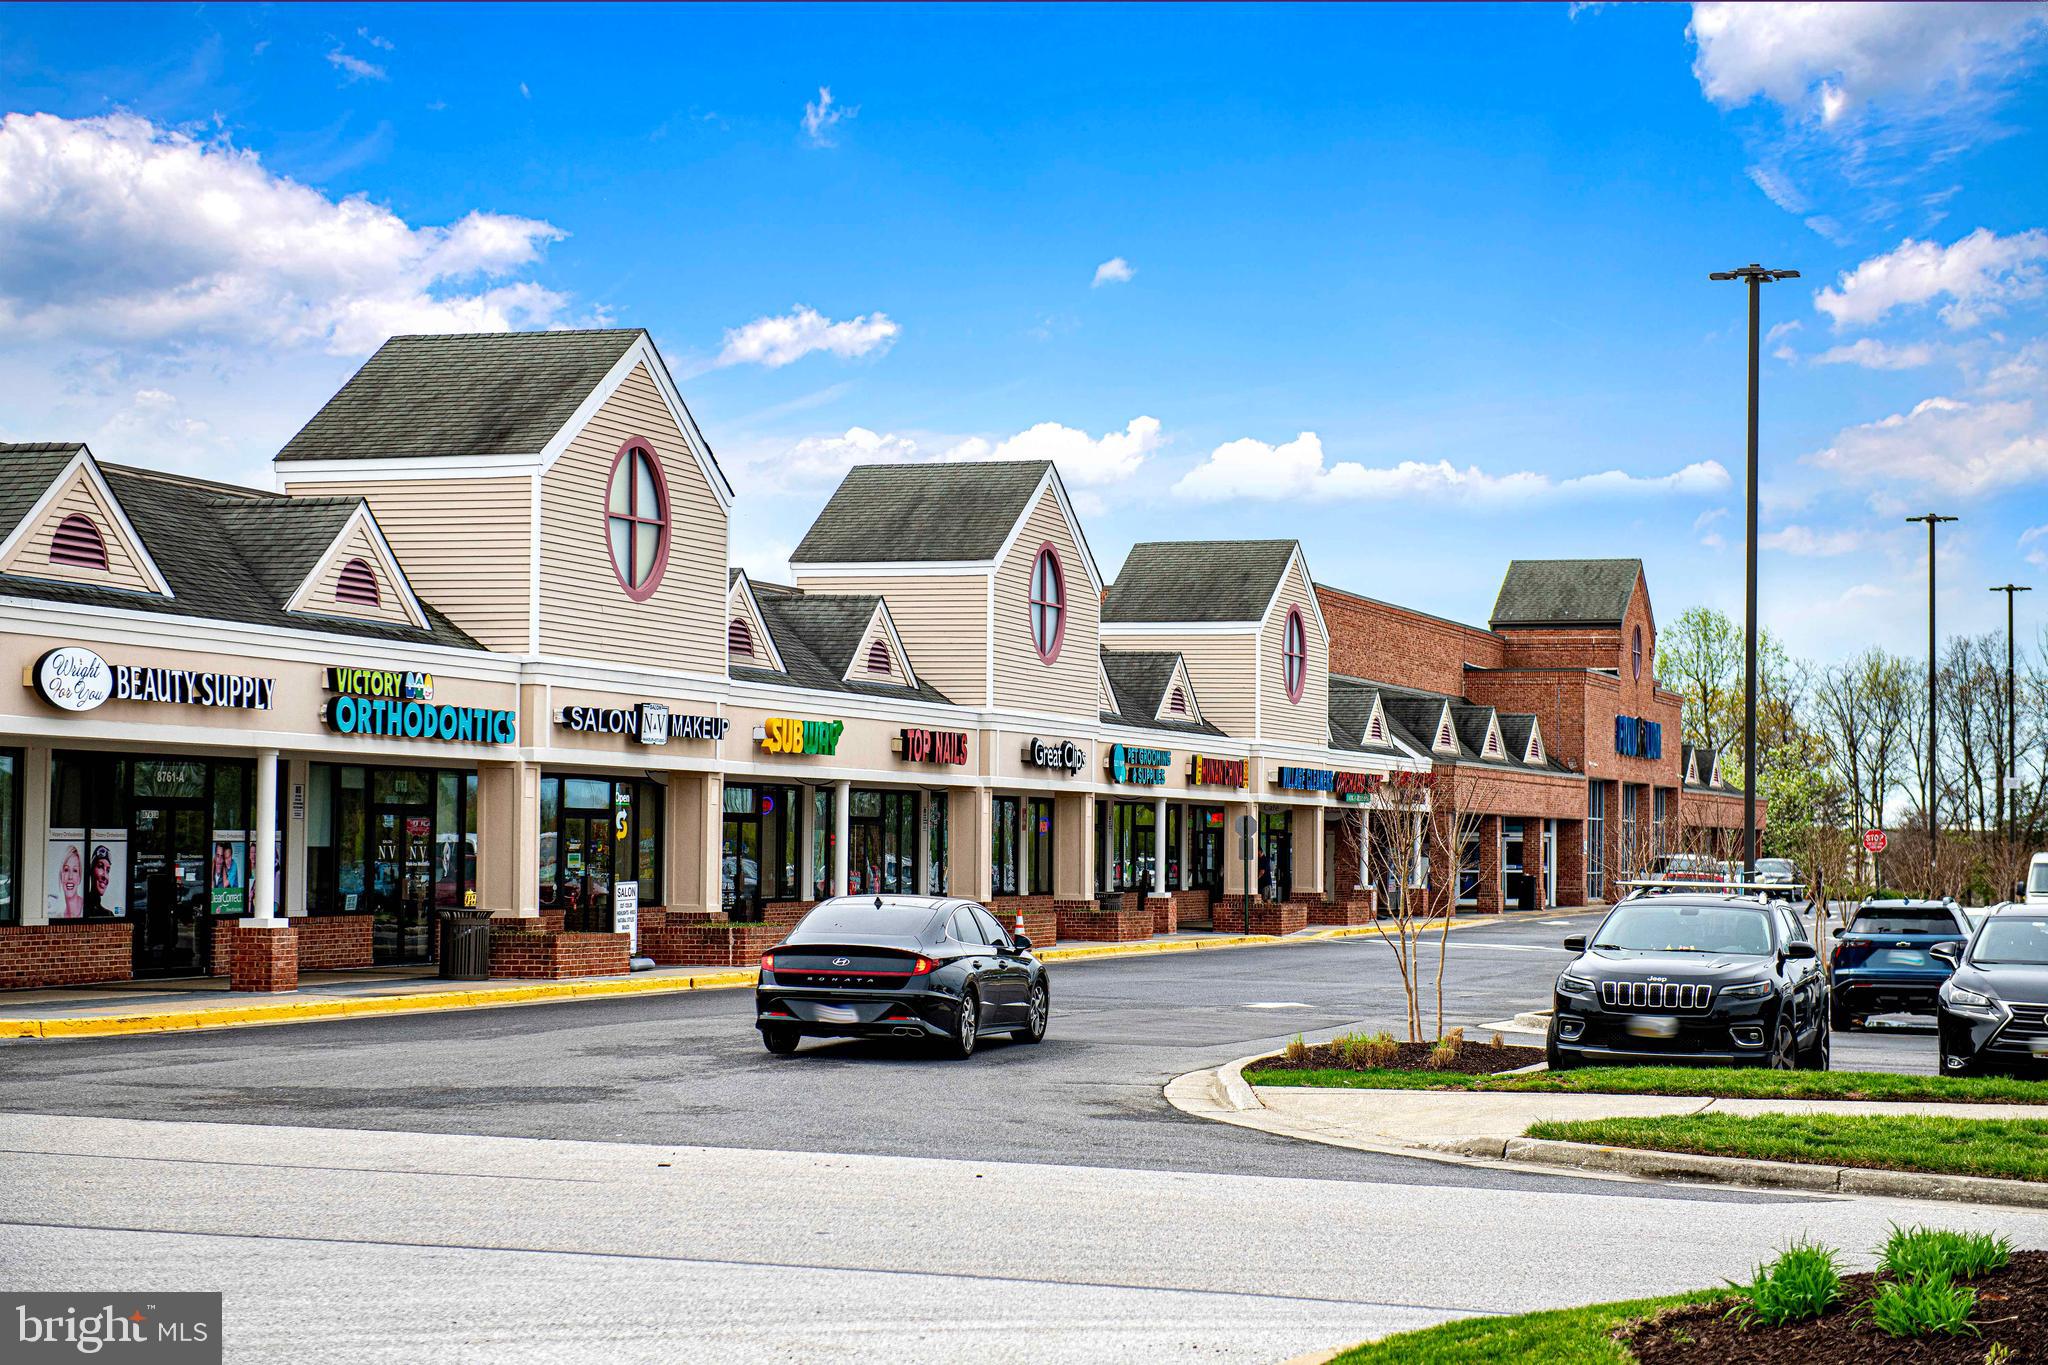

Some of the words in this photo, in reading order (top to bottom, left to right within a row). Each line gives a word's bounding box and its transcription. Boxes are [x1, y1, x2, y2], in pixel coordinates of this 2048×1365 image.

[52, 653, 101, 684] Wright
[336, 667, 402, 697] VICTORY
[49, 678, 72, 700] For
[74, 681, 103, 706] You
[117, 665, 198, 704] BEAUTY
[201, 673, 276, 710] SUPPLY
[336, 695, 516, 744] ORTHODONTICS
[570, 706, 637, 735] SALON
[672, 714, 730, 740] MAKEUP
[761, 717, 844, 756] SUBWAY
[908, 728, 931, 762] TOP
[935, 731, 968, 765] NAILS
[1034, 740, 1063, 767] Great
[1064, 740, 1087, 773] Clips
[1127, 747, 1139, 764] PET
[1139, 748, 1171, 766] GROOMING
[156, 771, 185, 783] 8761-A
[1138, 767, 1165, 785] SUPPLIES
[1202, 758, 1224, 785] HUNAN
[615, 791, 630, 802] Open
[617, 887, 636, 897] SALON
